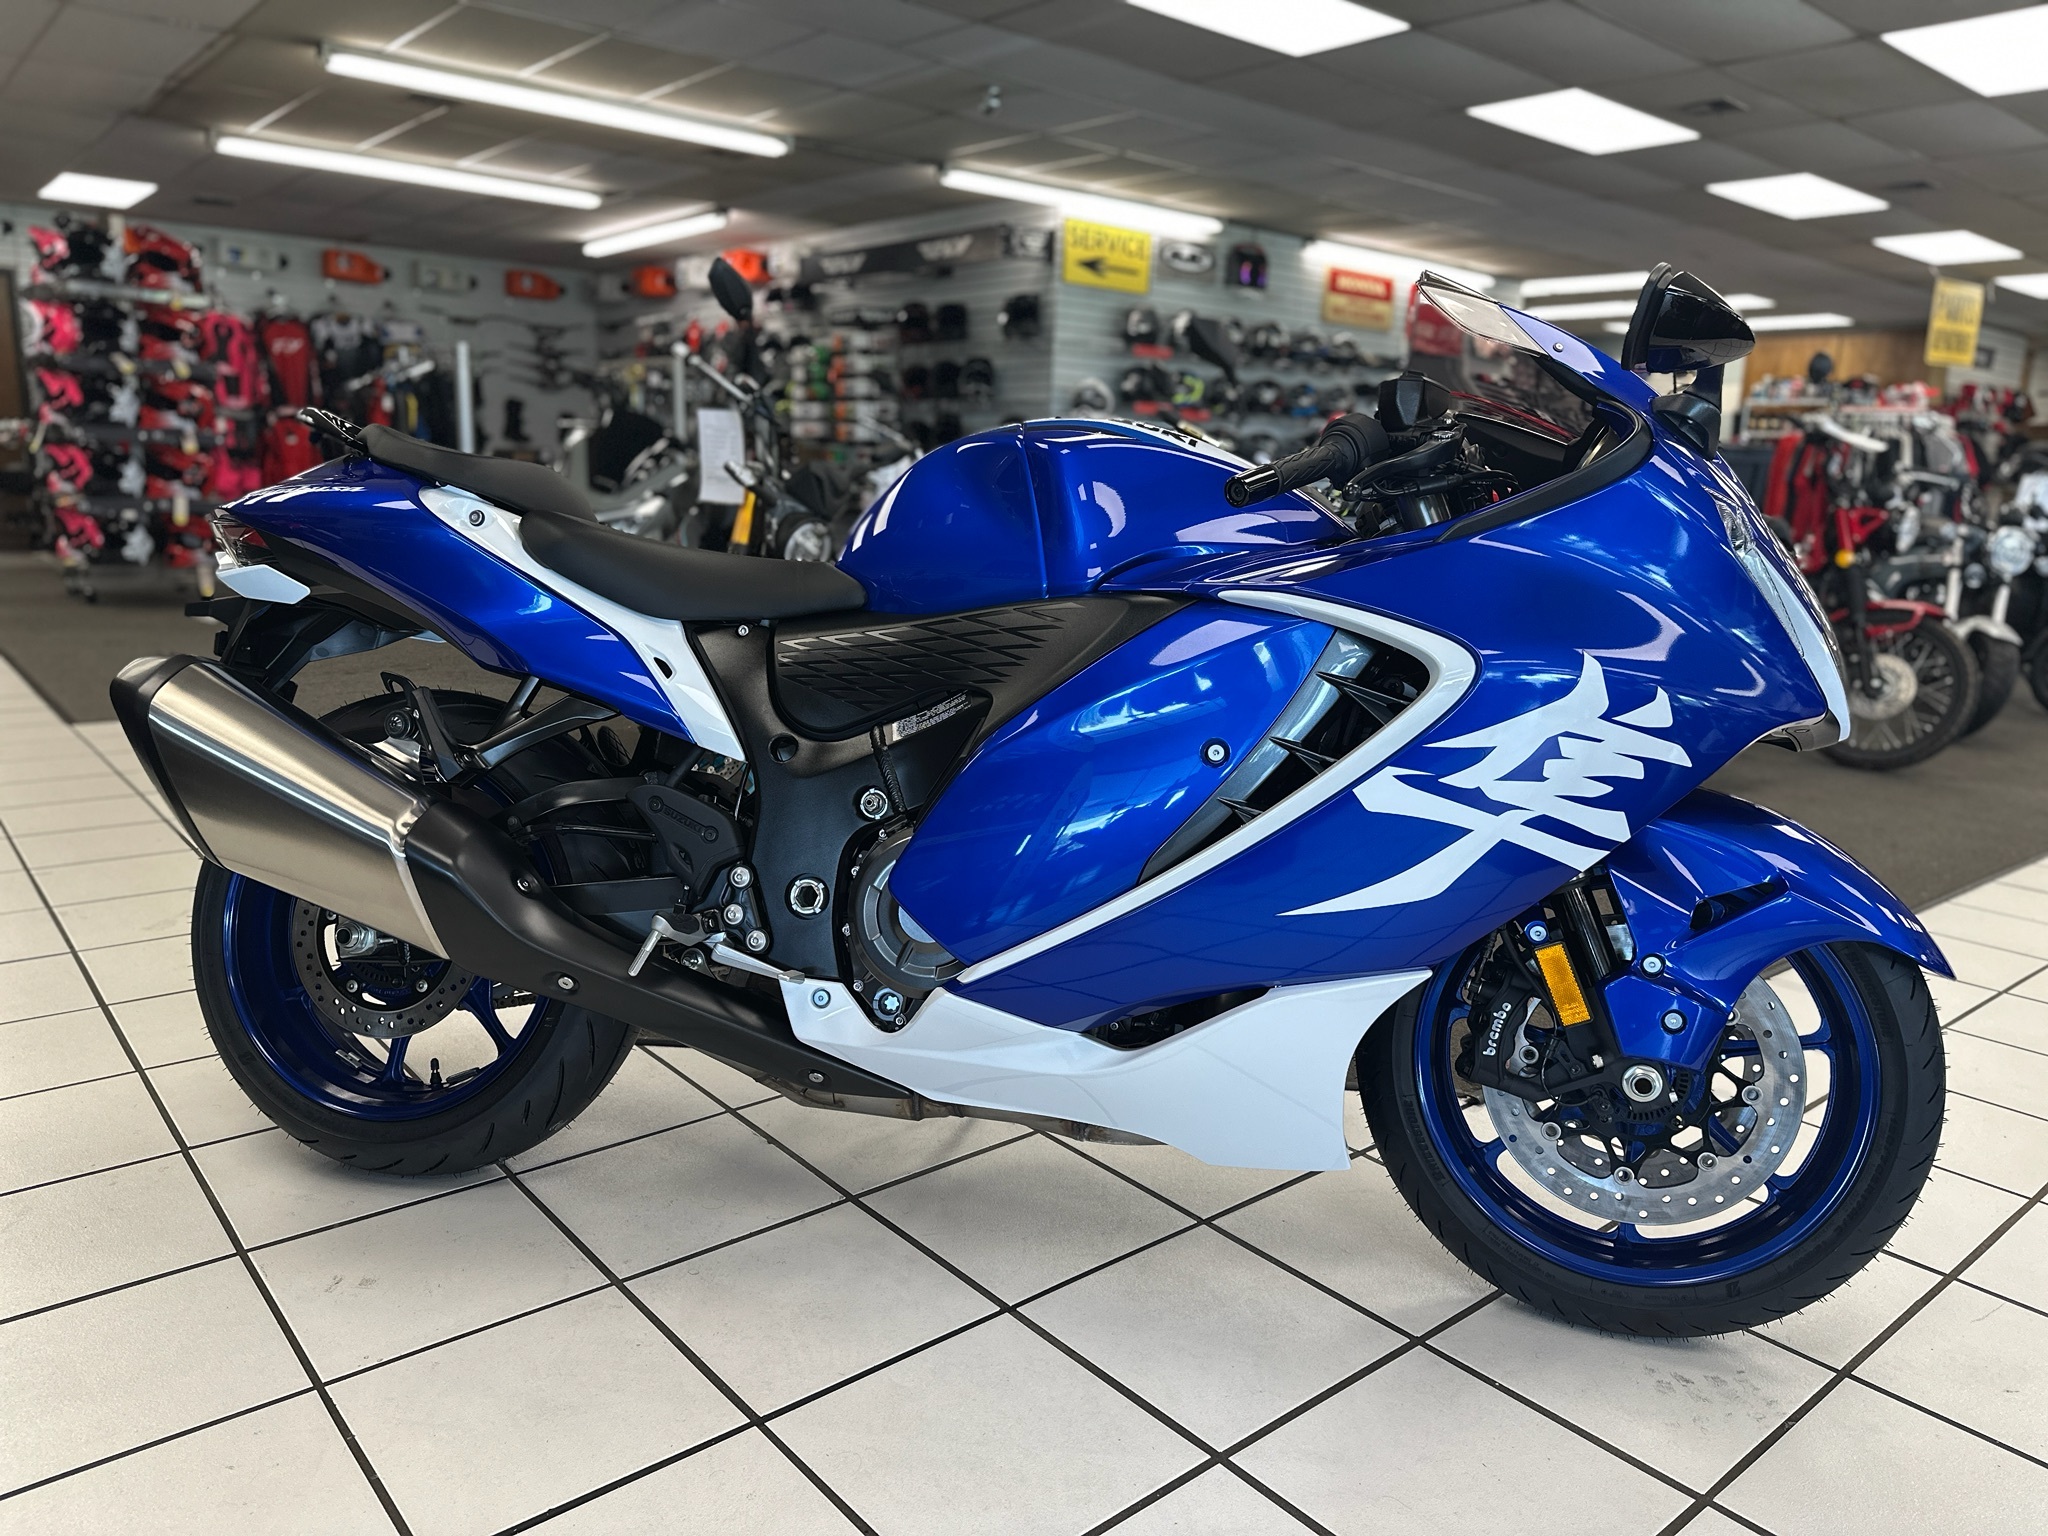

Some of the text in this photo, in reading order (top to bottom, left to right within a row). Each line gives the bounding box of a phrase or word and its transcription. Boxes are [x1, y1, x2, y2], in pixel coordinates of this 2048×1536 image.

[1070, 226, 1147, 261] SERVICE
[662, 806, 704, 834] SUZUKI
[1482, 1002, 1513, 1056] brembo
